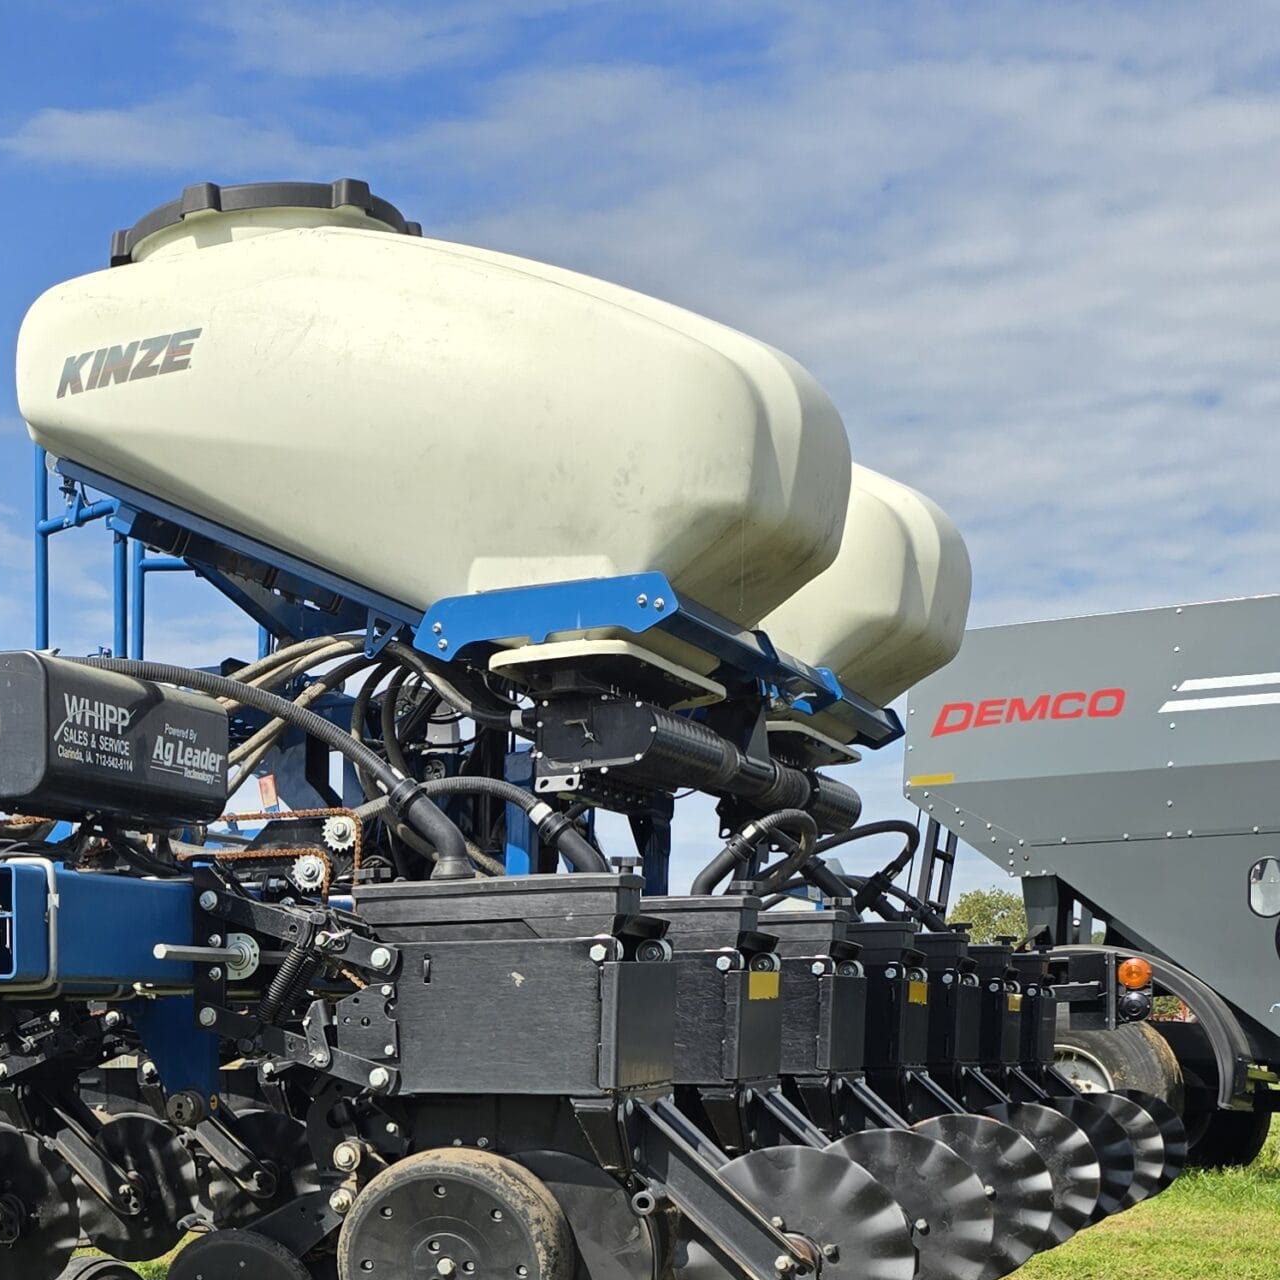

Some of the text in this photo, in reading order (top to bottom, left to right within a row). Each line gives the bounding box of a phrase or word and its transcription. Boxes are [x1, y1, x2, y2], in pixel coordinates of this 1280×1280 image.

[56, 327, 203, 399] KINZE
[64, 692, 130, 735] WHIPP
[931, 688, 1126, 738] DEMCO
[63, 726, 130, 756] SALES & SERVICE
[164, 723, 198, 744] Powered By
[152, 735, 226, 773] Ag Leader
[183, 767, 215, 785] Technology
